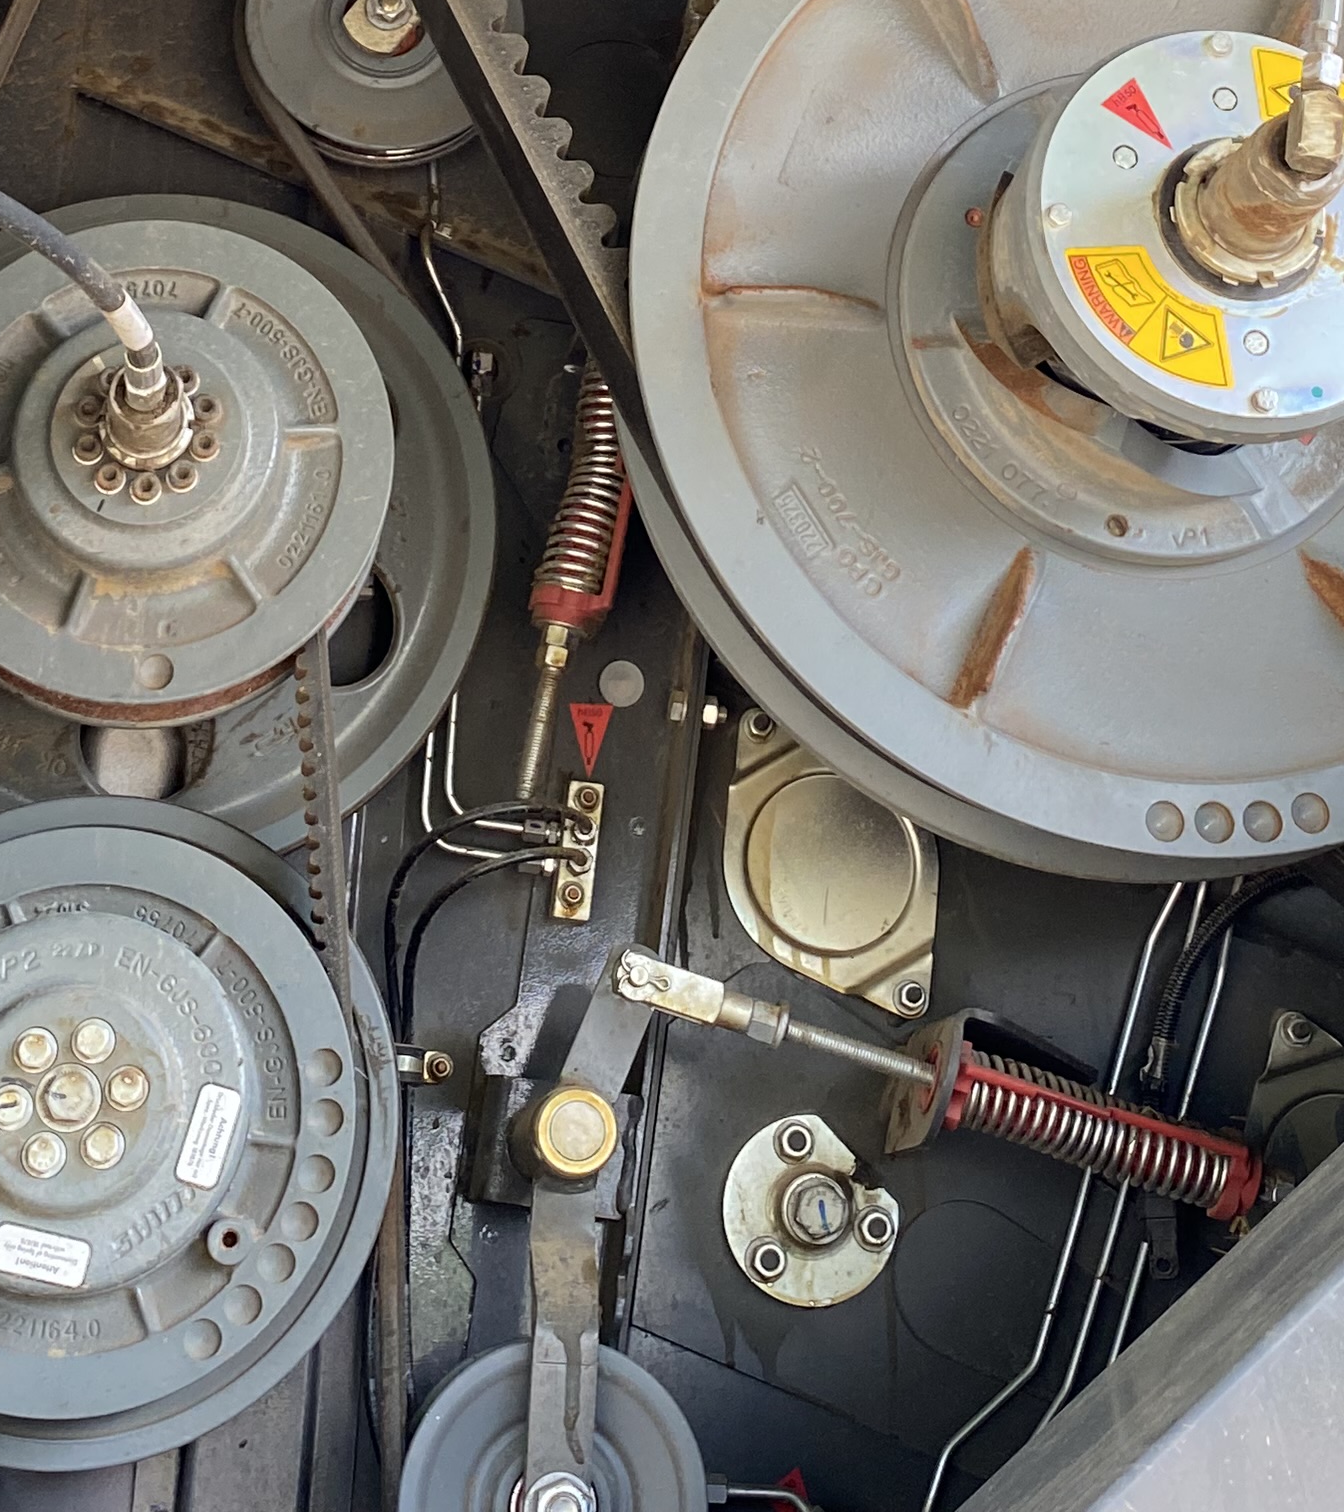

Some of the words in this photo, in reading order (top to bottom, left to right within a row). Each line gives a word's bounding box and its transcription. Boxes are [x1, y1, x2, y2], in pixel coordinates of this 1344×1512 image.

[119, 279, 177, 299] 7075
[1073, 258, 1122, 332] WARNING
[207, 1116, 227, 1159] Achtung!
[15, 1256, 60, 1275] Attention!
